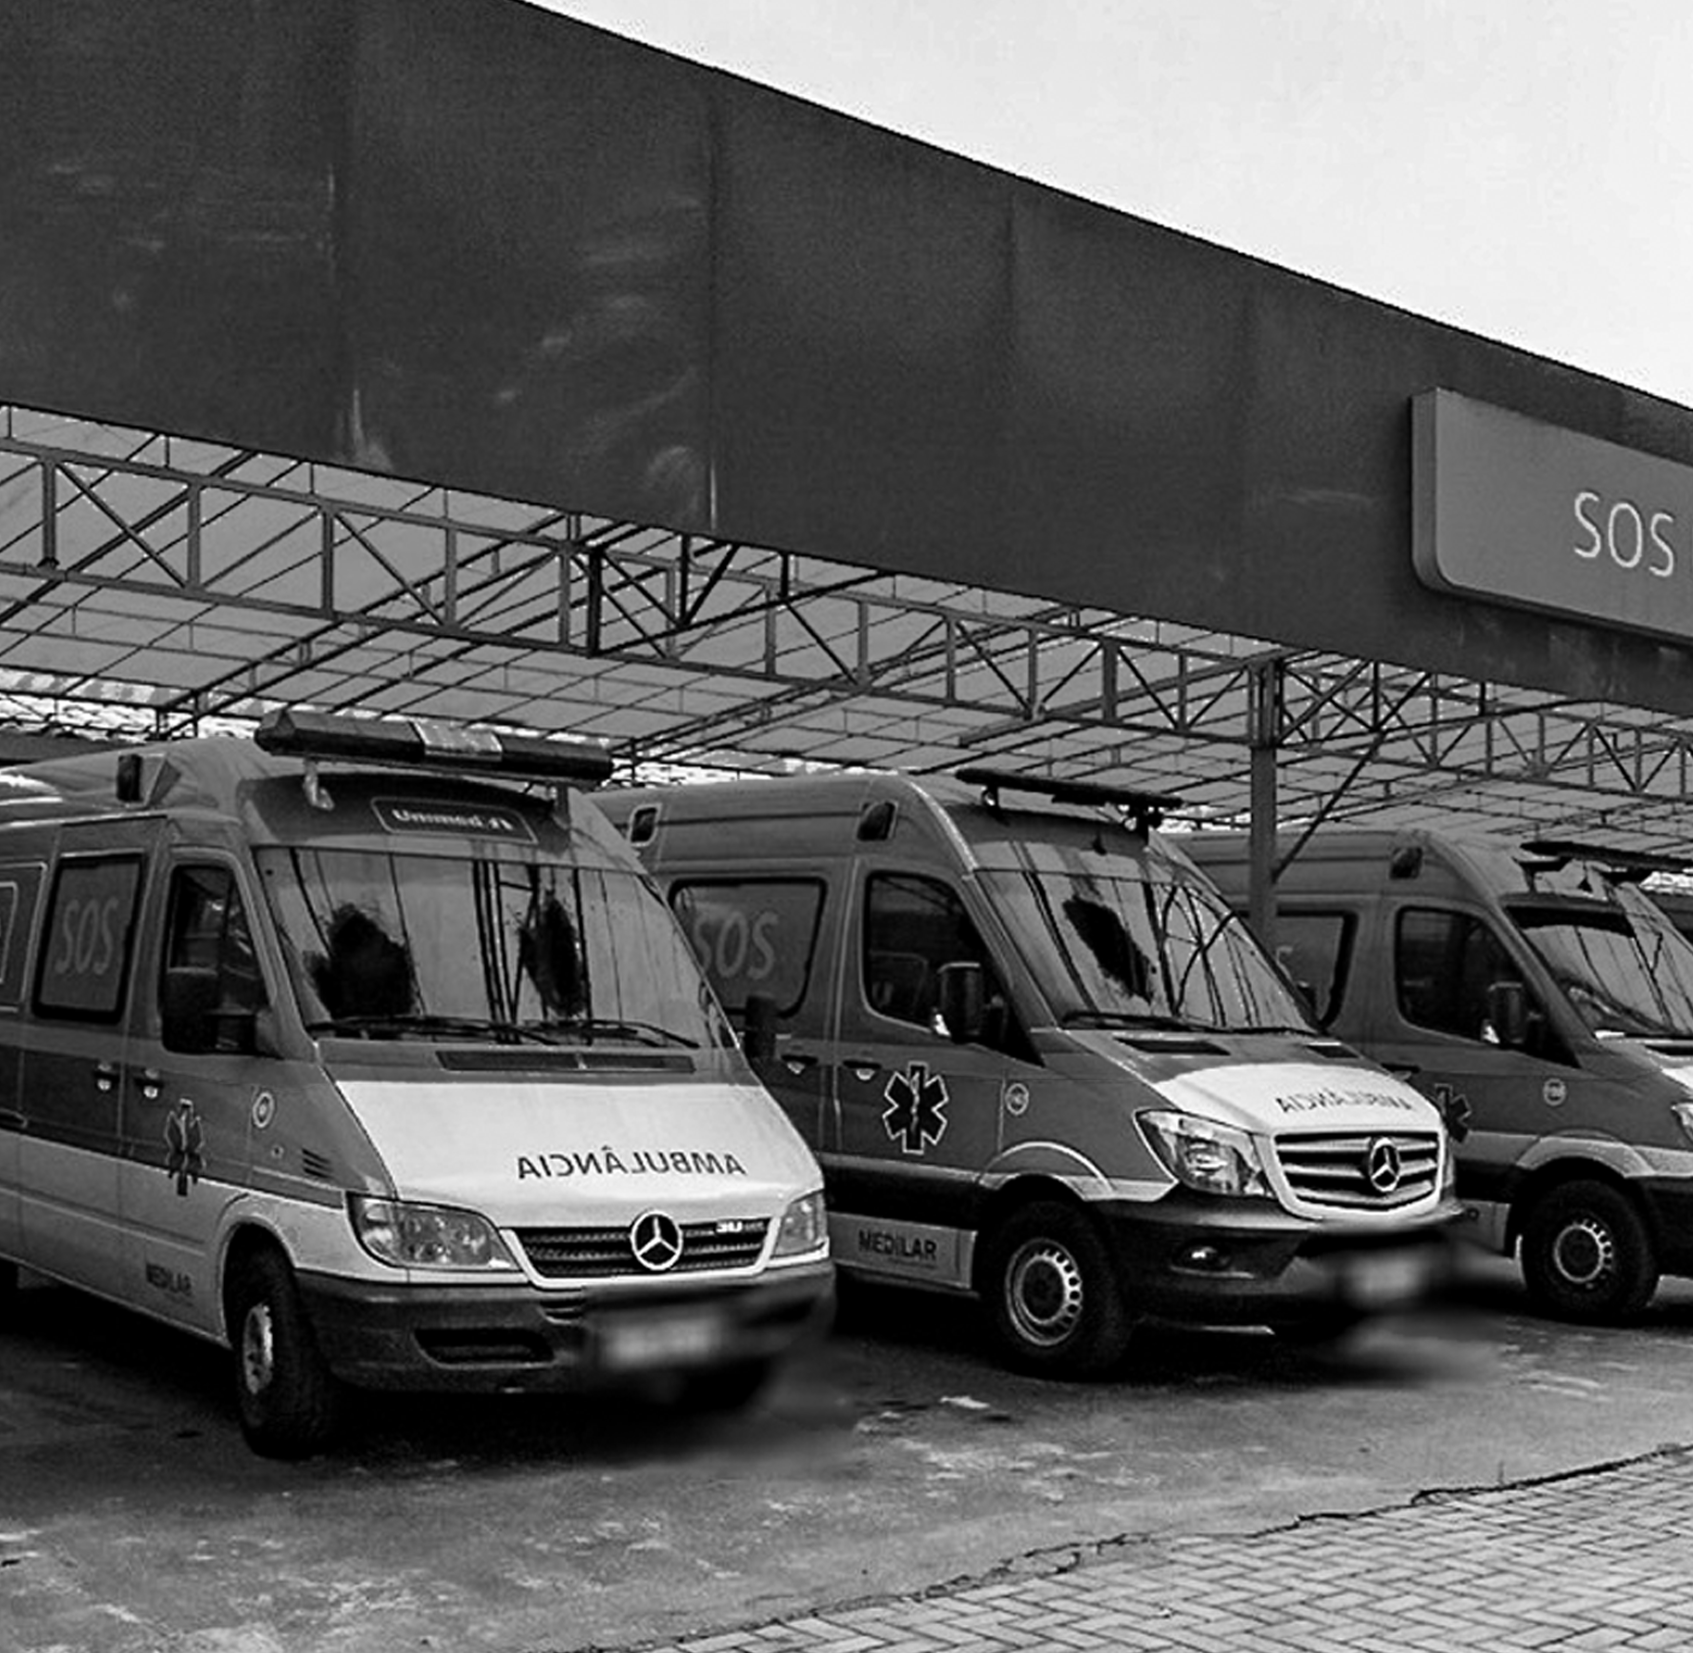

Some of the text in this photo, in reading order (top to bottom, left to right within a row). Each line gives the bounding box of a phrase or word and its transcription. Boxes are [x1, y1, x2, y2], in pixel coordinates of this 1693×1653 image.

[1573, 491, 1674, 577] SOS
[57, 897, 119, 975] SOS
[692, 910, 779, 980] SOS
[858, 1229, 937, 1261] MEDILAR
